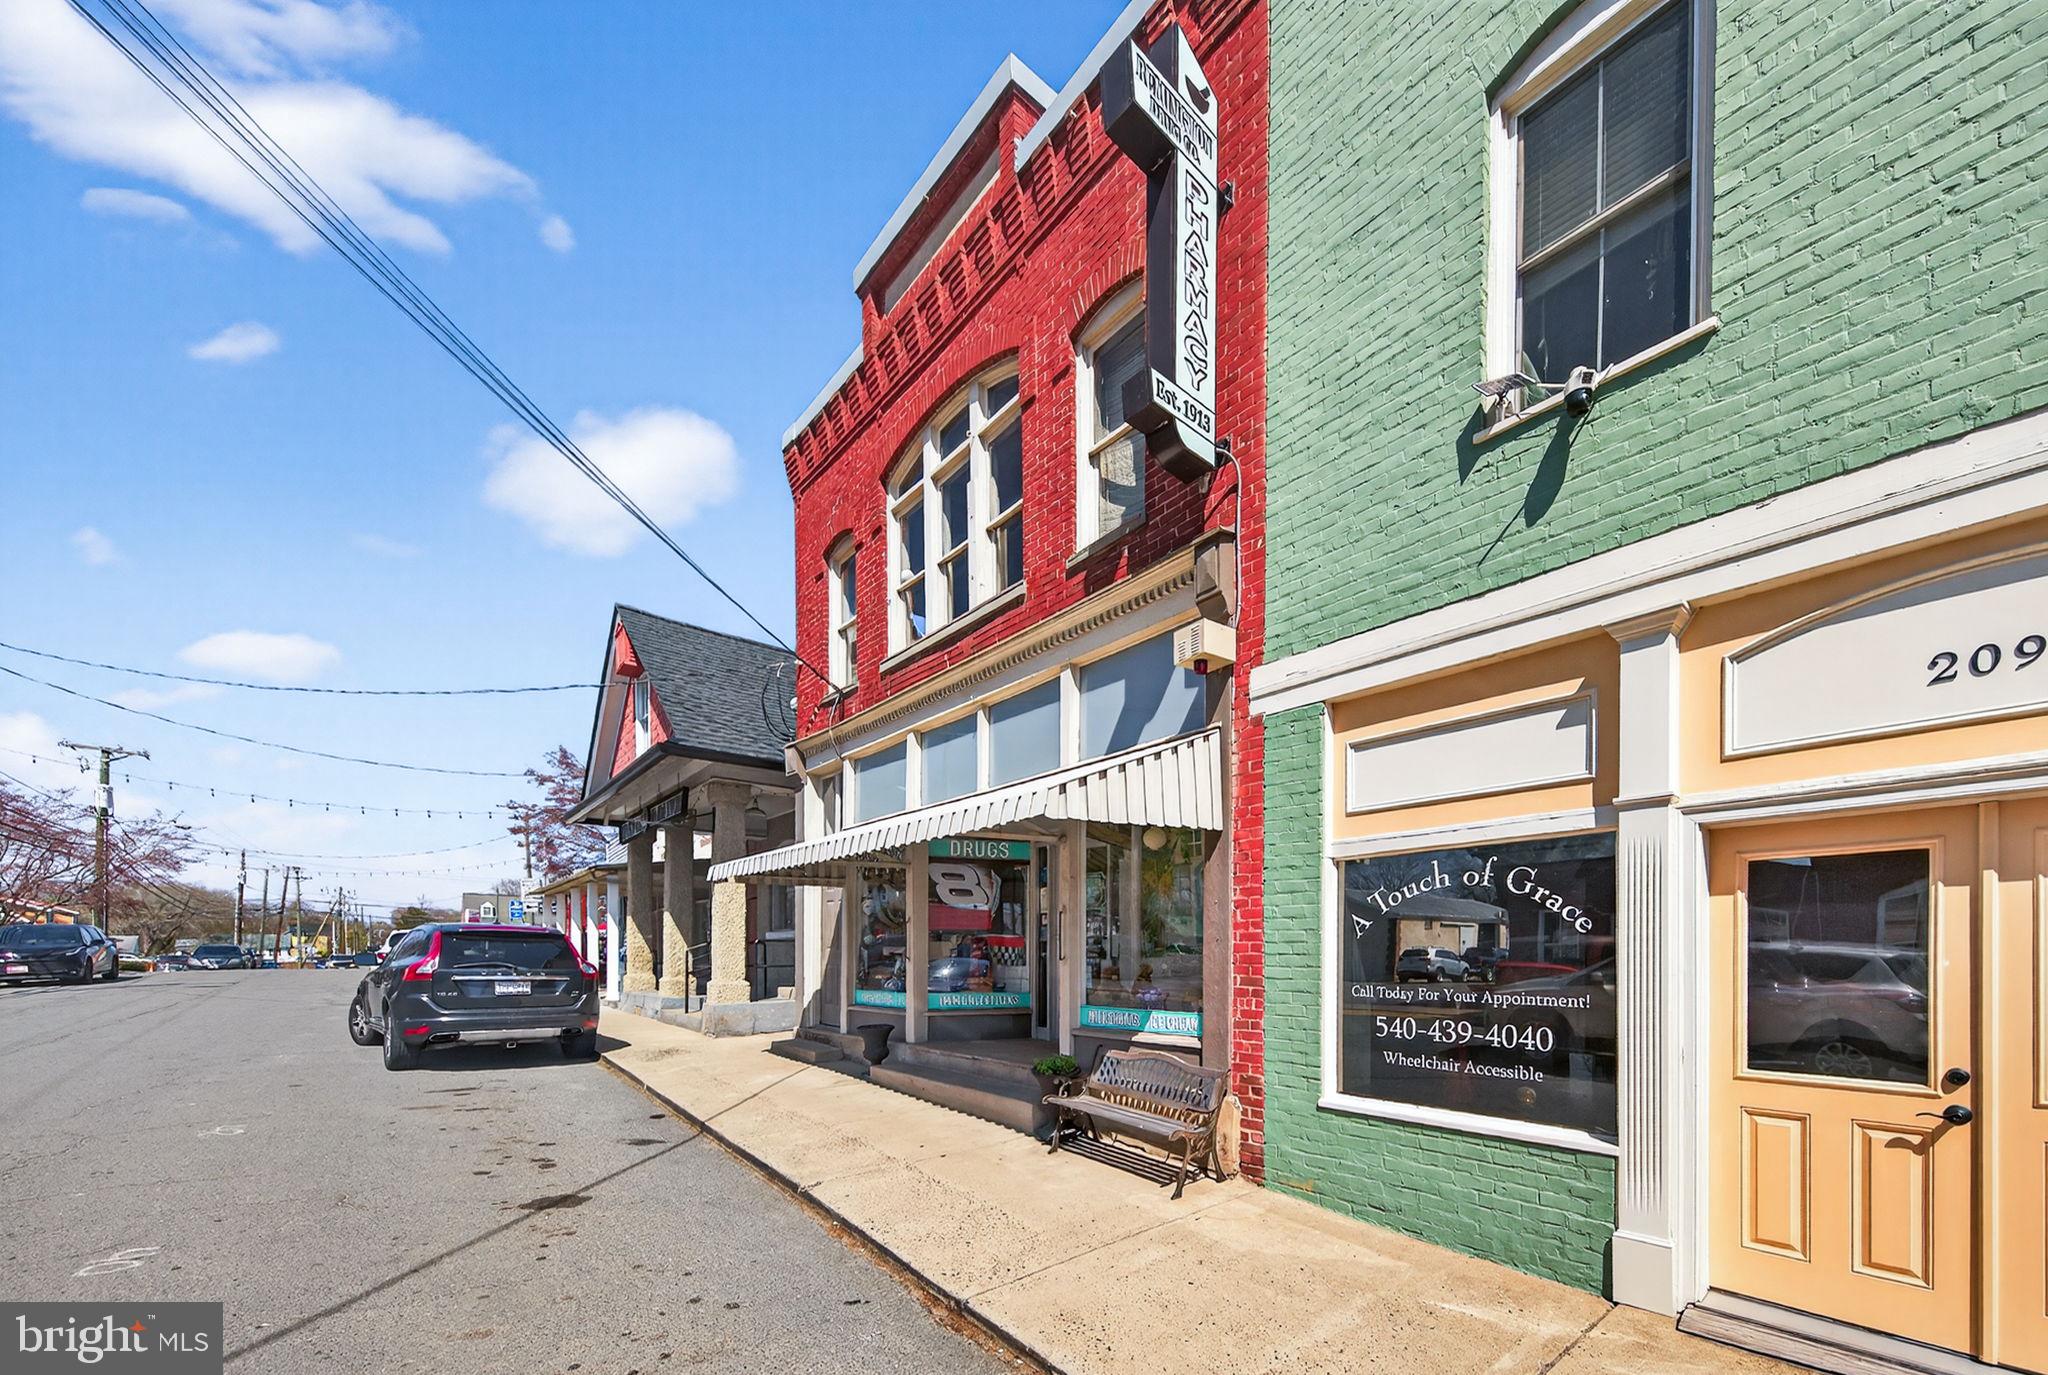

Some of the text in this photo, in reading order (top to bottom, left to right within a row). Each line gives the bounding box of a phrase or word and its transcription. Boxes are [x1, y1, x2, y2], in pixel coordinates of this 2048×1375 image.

[1184, 168, 1209, 392] PHARMACY
[1183, 399, 1211, 434] 1913
[1926, 633, 2048, 688] 209
[950, 840, 1010, 859] DRUGS
[1350, 855, 1593, 939] A Touch of Grace
[1351, 985, 1591, 1009] Call Today For Your Appointment!
[1375, 1016, 1554, 1052] 540-439-4040
[1383, 1050, 1544, 1083] Wheelchair Accessible
